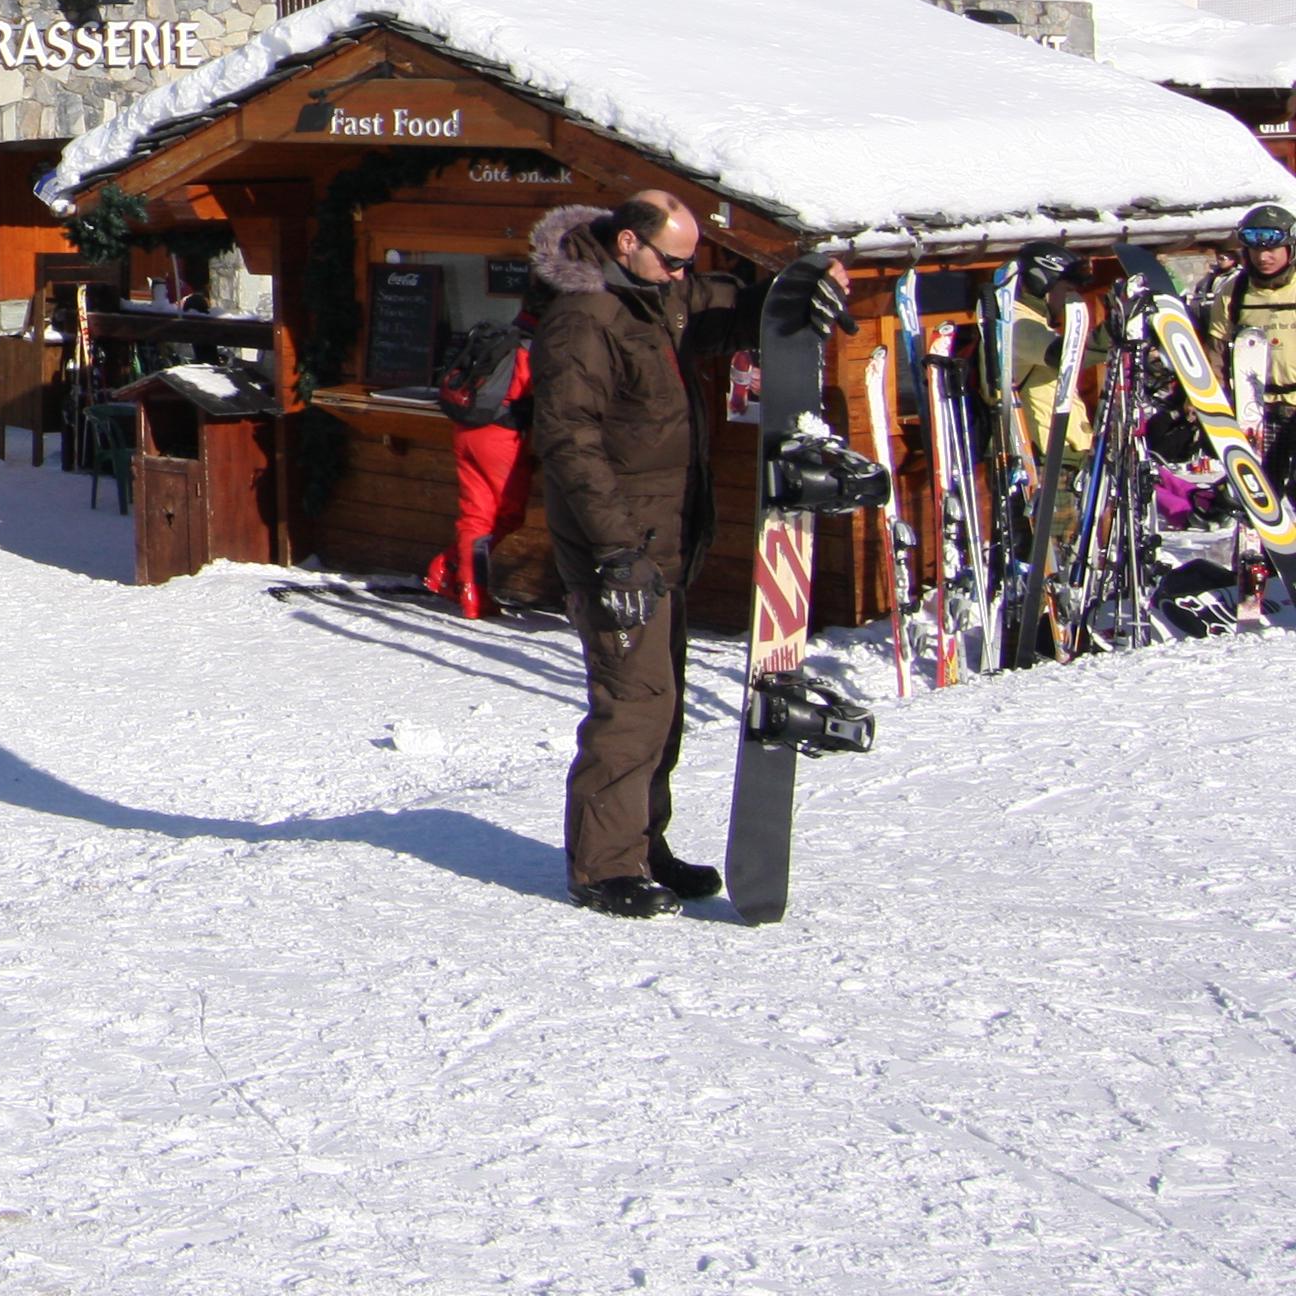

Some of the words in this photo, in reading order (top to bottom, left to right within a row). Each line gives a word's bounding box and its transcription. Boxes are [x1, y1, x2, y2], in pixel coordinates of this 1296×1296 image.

[330, 108, 384, 136] Fast
[392, 108, 461, 137] Food
[1069, 309, 1082, 364] HEAD
